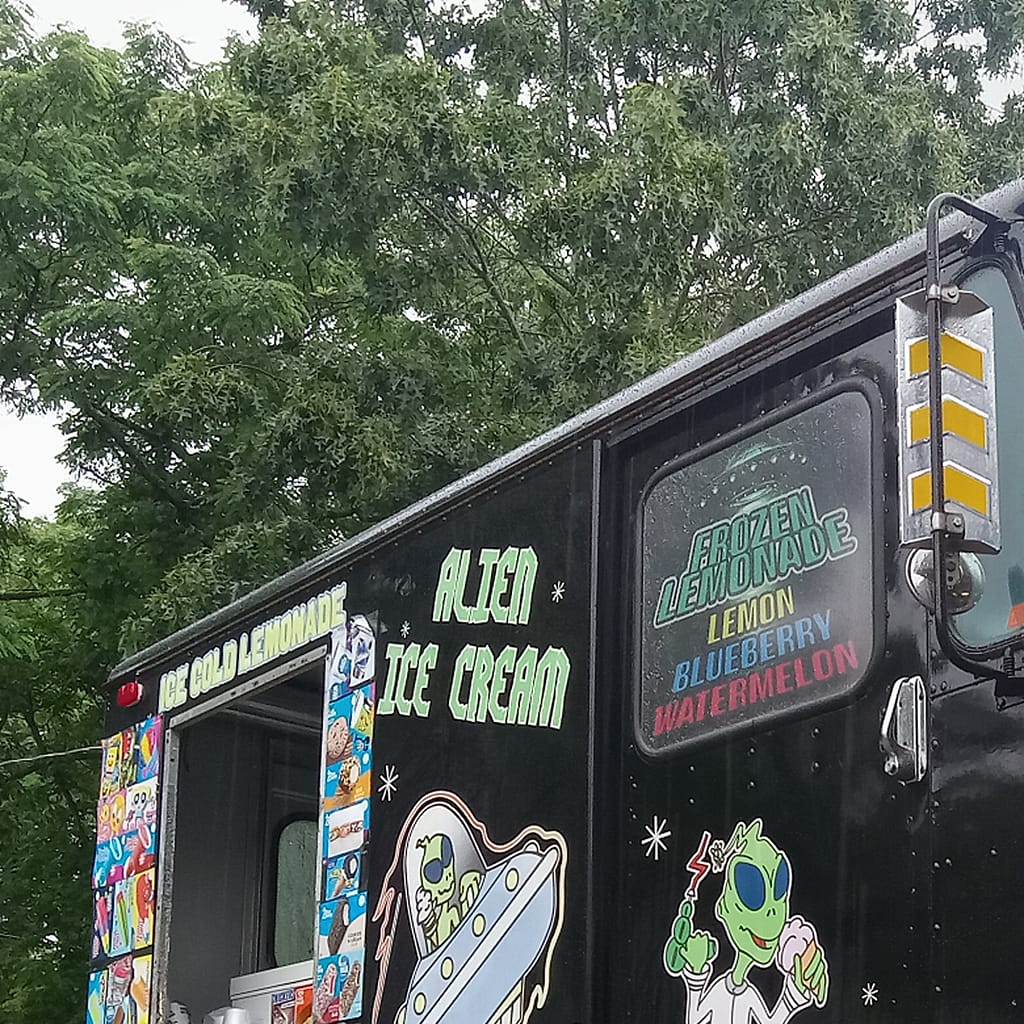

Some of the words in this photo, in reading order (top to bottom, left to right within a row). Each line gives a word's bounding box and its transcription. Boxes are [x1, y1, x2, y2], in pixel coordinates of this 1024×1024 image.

[654, 507, 859, 628] LEMONADE
[689, 486, 817, 575] FROZEN
[433, 547, 539, 625] ALIEN
[707, 584, 795, 646] LEMON
[158, 662, 190, 714] ICE
[189, 638, 239, 699] COLD
[238, 581, 348, 675] LEMONADE
[379, 643, 439, 717] ICE
[449, 644, 571, 730] CREAM
[653, 640, 860, 737] WATERMELON
[672, 609, 834, 695] BLUEBERRY
